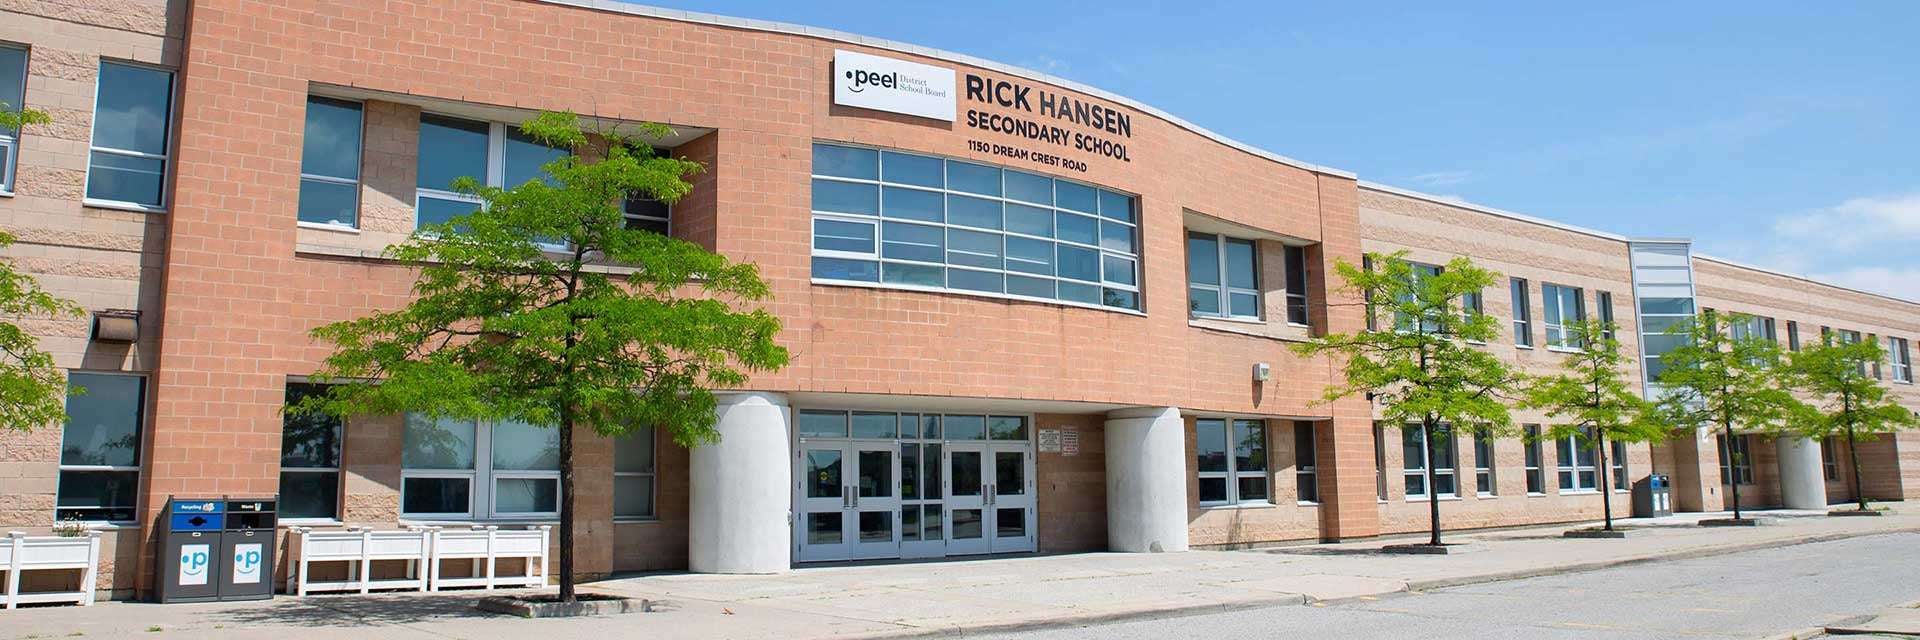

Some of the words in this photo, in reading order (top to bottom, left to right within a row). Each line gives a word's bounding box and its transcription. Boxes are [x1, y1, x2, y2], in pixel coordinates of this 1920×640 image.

[899, 75, 927, 86] District
[899, 83, 923, 94] School
[924, 88, 946, 98] Board
[966, 74, 1032, 112] RICK
[1040, 91, 1131, 138] HANSEN
[967, 110, 1070, 145] SECONDARY
[1075, 133, 1130, 162] SCHOOL
[967, 140, 990, 153] 1150
[993, 145, 1028, 161] DREAM
[1031, 152, 1059, 168] CREST
[1062, 159, 1087, 172] ROAD
